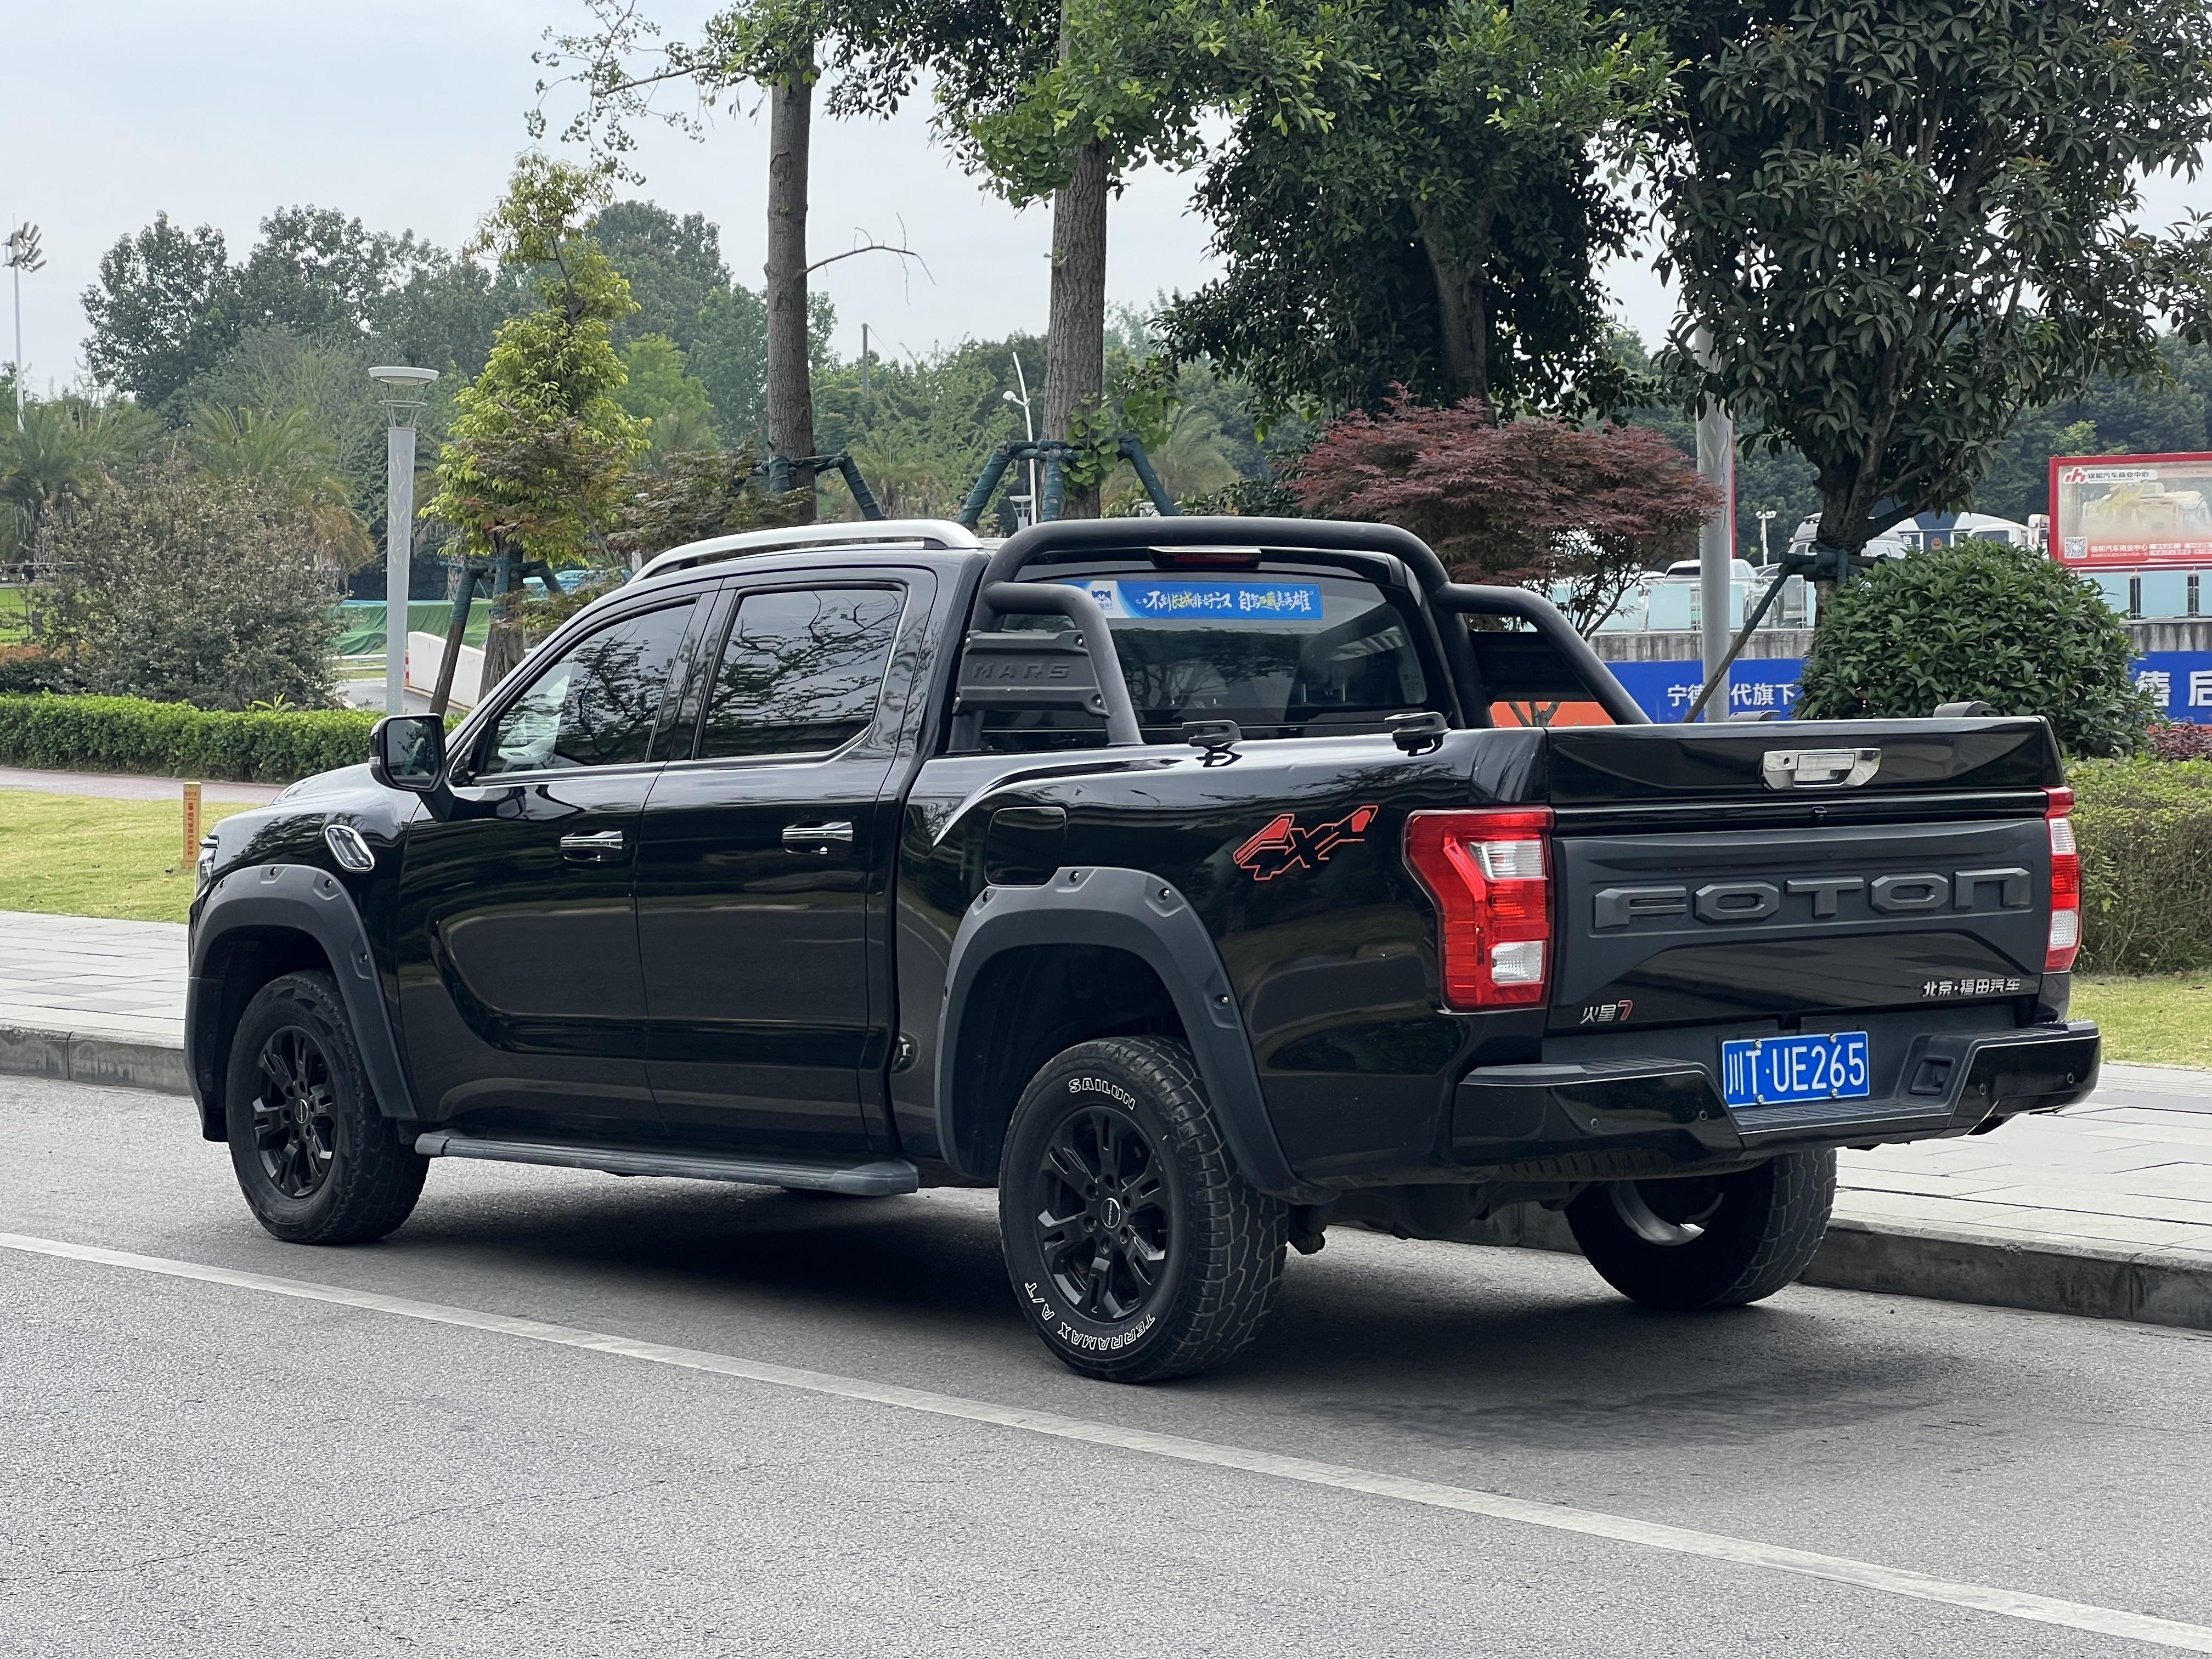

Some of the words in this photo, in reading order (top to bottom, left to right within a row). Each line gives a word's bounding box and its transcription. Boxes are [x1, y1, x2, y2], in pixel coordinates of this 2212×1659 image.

[972, 662, 1071, 679] MARS
[1594, 867, 2031, 929] FOTON
[1580, 1000, 1633, 1024] 火星7
[1069, 1077, 1136, 1110] SAILUN
[1025, 1282, 1055, 1321] A/T
[1058, 1313, 1155, 1351] TERRAMAX
